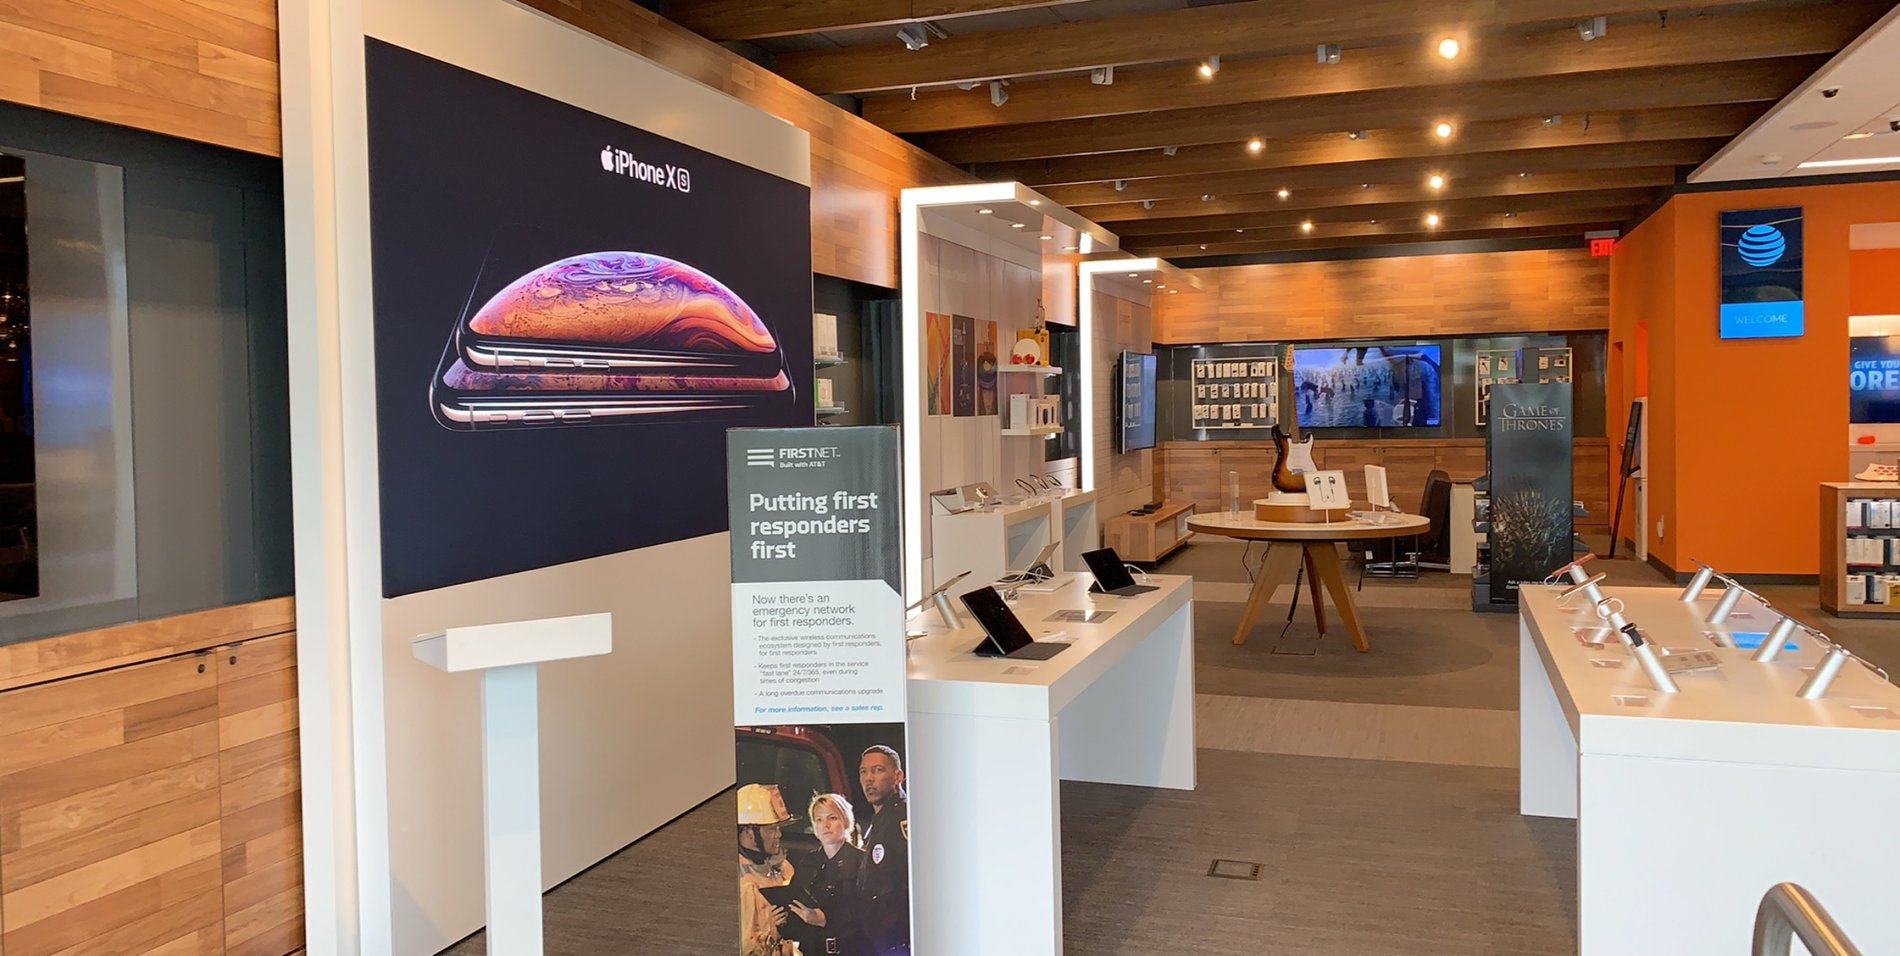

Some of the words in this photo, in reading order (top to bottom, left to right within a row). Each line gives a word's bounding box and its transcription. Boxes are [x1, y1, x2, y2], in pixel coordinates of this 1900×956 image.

[615, 148, 665, 186] iPhone
[1735, 314, 1788, 324] WELCOME
[1854, 360, 1877, 369] GIVE
[1850, 370, 1900, 391] ORE
[1503, 404, 1548, 418] GAME
[1501, 420, 1564, 432] THRONES
[750, 492, 828, 514] Putting
[833, 491, 878, 510] first
[750, 515, 870, 538] responders
[750, 540, 796, 559] first
[752, 595, 776, 604] Now
[780, 594, 814, 603] there's
[817, 594, 830, 603] an
[752, 606, 810, 617] emergency
[814, 605, 855, 614] network
[752, 618, 767, 627] for
[770, 617, 789, 626] first
[792, 616, 854, 628] responders.
[786, 677, 819, 685] congestion
